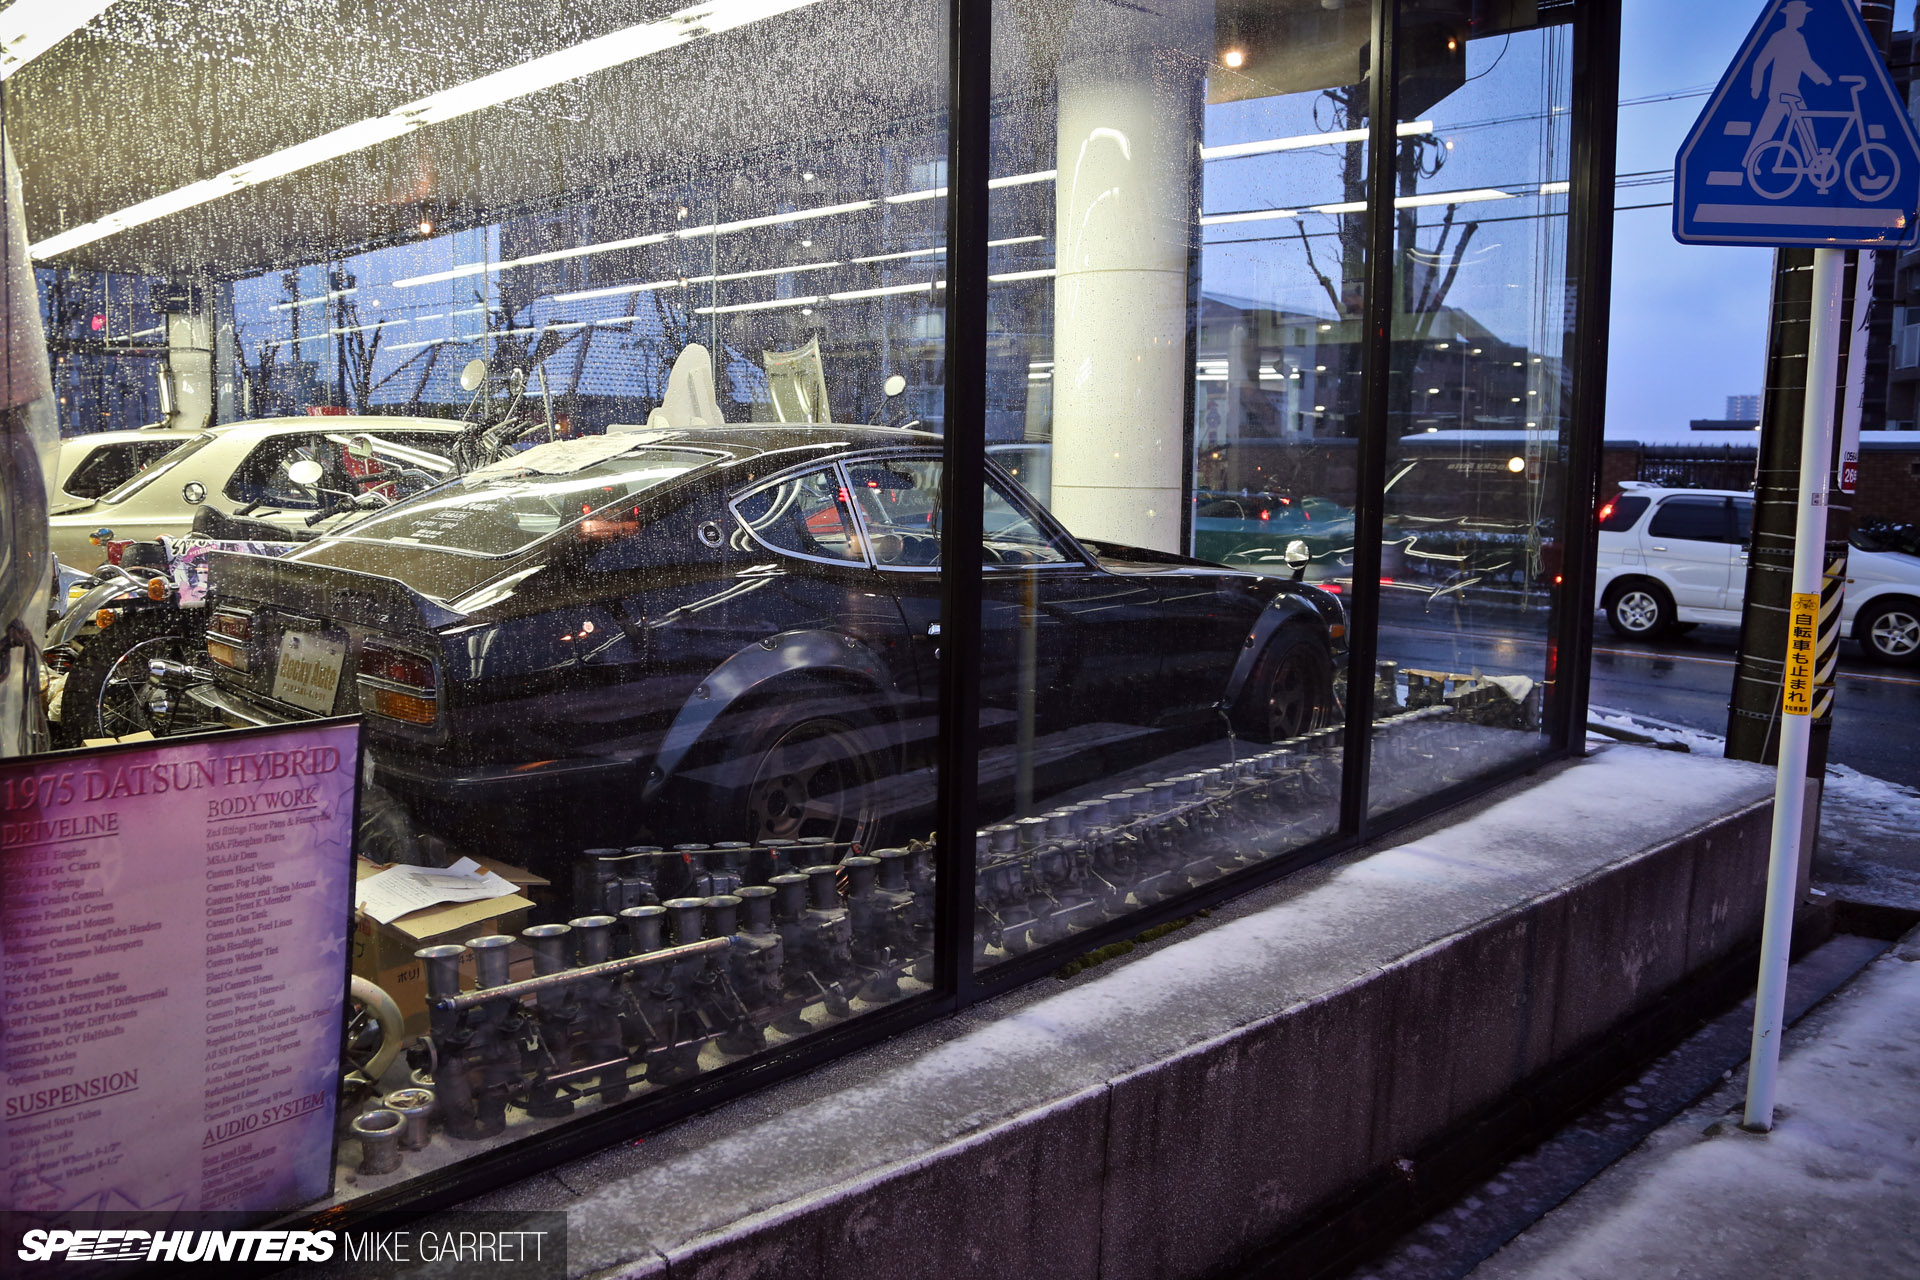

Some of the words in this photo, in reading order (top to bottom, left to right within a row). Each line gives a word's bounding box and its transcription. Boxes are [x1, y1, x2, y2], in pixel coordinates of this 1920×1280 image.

[1788, 614, 1813, 703] 自転車も止まれ
[4, 772, 75, 811] 1975
[81, 757, 217, 803] DATSUN
[223, 745, 340, 785] HYBRID
[207, 795, 259, 818] BODY
[261, 787, 318, 809] WORK
[1, 811, 120, 846] DRIVELINE
[38, 866, 64, 877] Hot
[68, 862, 101, 872] Cam
[94, 939, 144, 955] Motorsports
[5, 1068, 140, 1118] SUSPENSION
[202, 1113, 259, 1146] AUDIO
[262, 1089, 326, 1125] SYSTEM
